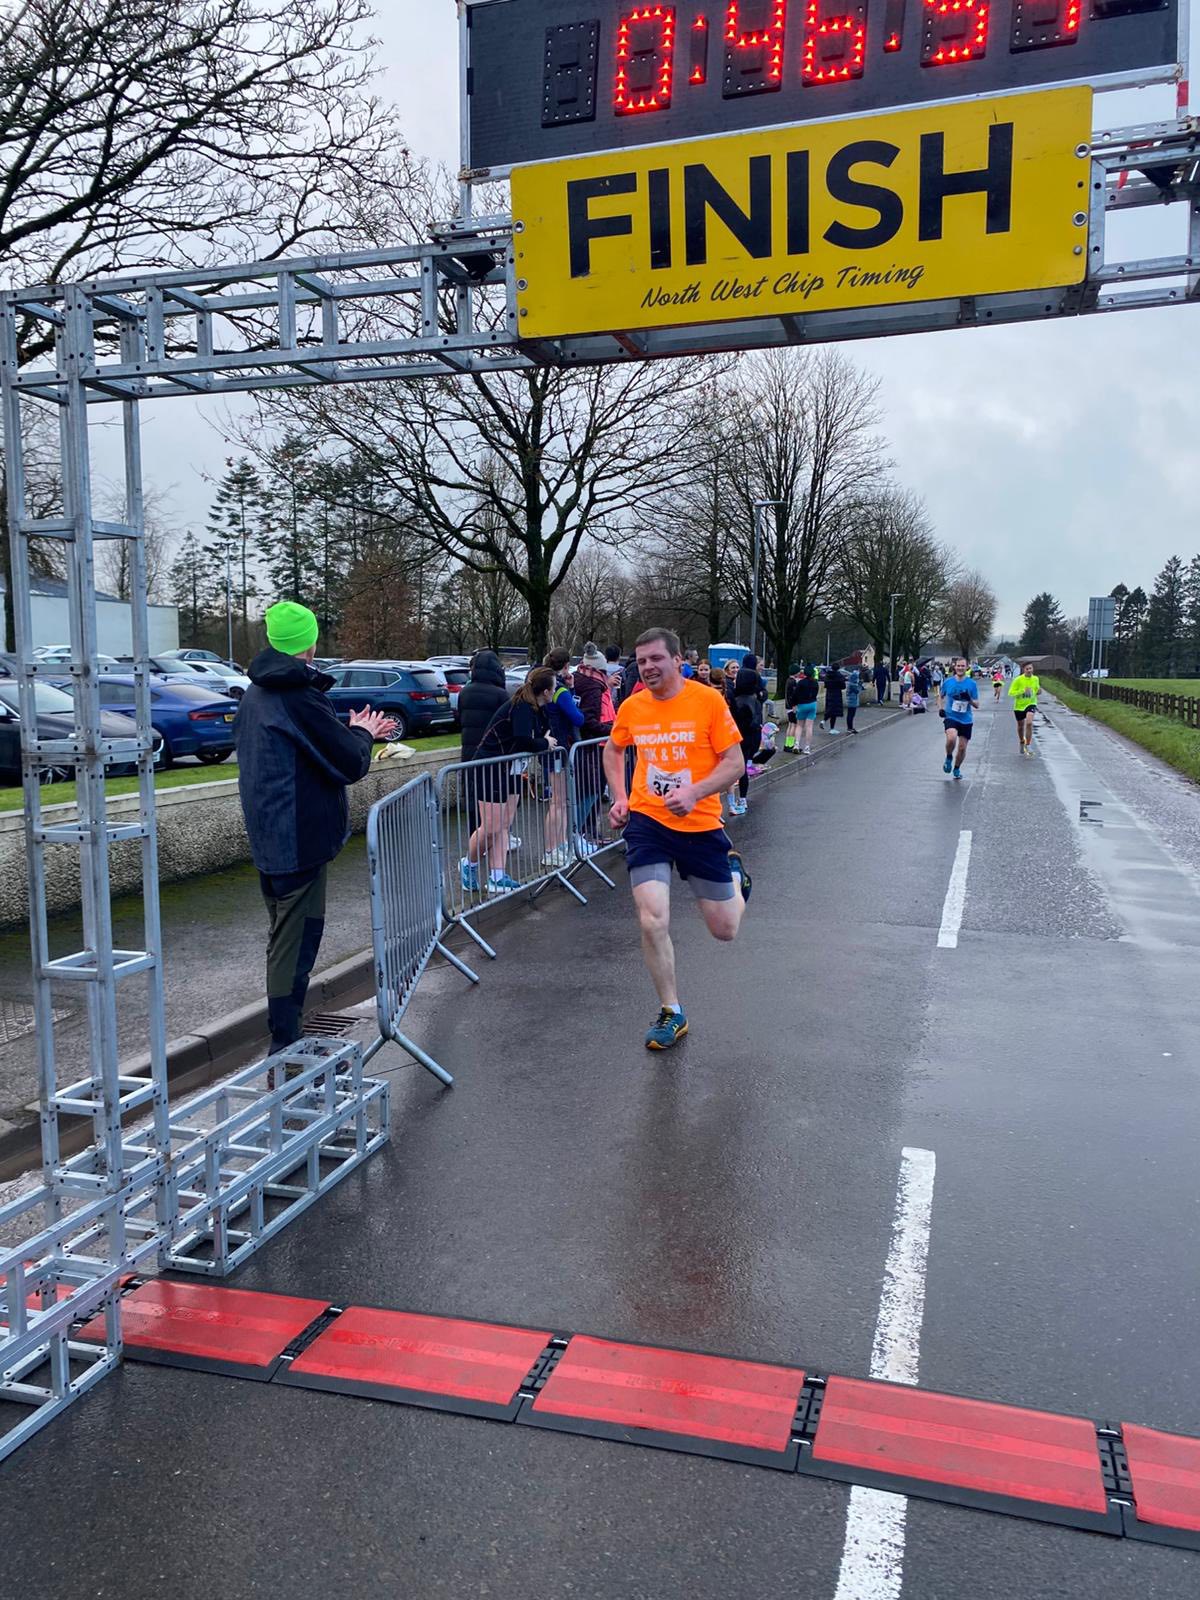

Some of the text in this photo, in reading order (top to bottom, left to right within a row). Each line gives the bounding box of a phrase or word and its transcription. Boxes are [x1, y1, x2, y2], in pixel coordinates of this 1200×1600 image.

[567, 122, 1014, 277] FINISH
[641, 263, 925, 308] North West Chip Timing
[661, 747, 669, 761] &
[672, 746, 687, 760] 5K
